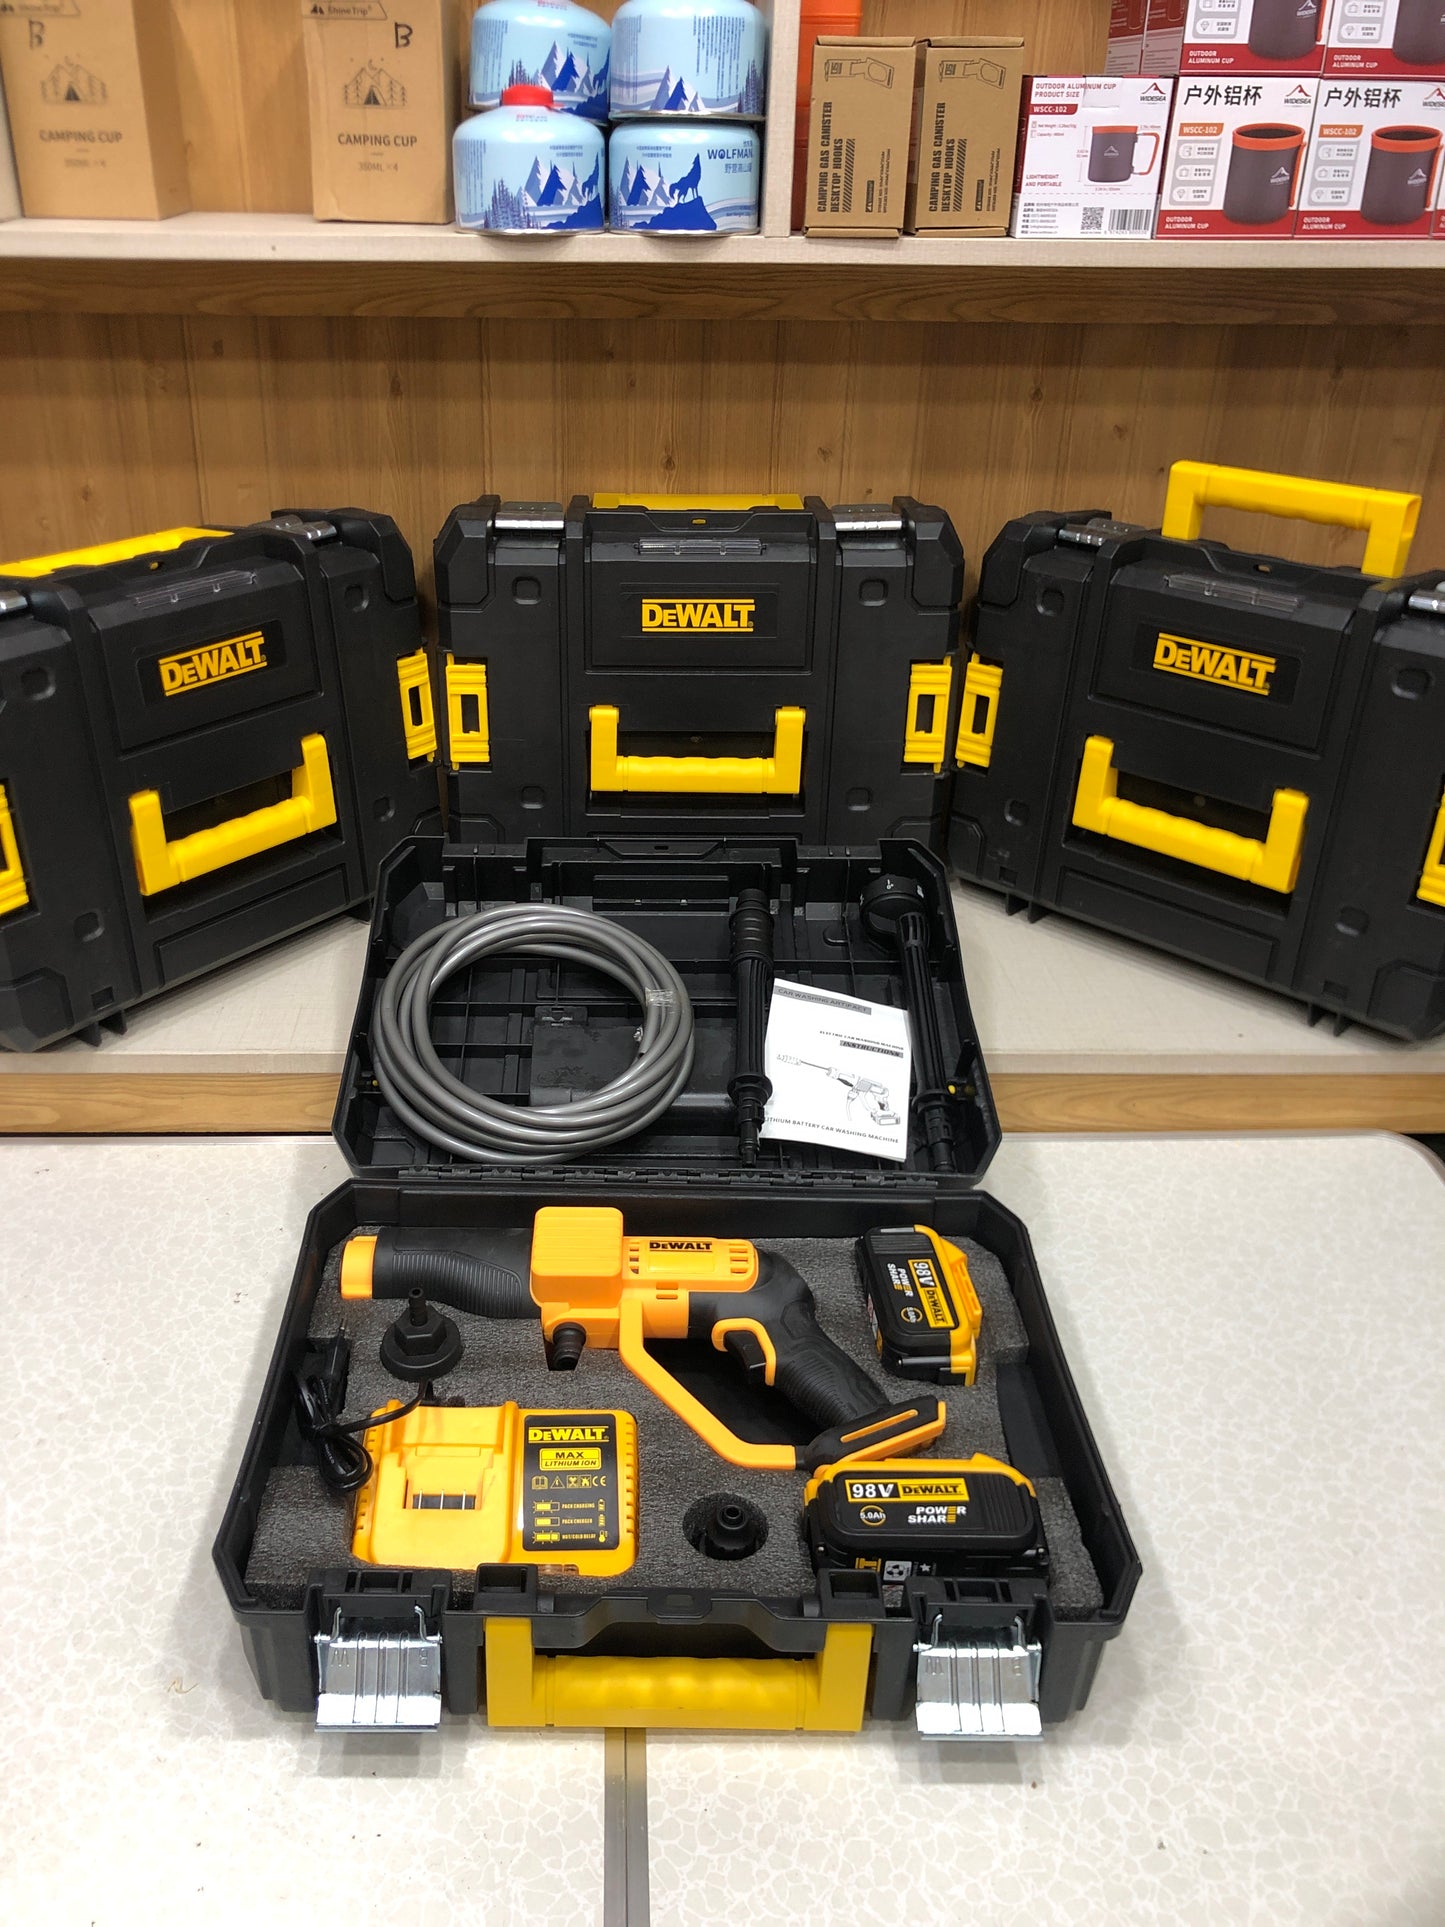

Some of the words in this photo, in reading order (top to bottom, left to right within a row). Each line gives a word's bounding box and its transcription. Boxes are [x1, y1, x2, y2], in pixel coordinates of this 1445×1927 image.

[28, 19, 45, 49] B
[394, 22, 413, 49] B
[1183, 85, 1263, 106] 户外铝杯
[1323, 87, 1403, 109] 户外铝杯
[821, 102, 832, 147] CANISTER
[934, 102, 946, 148] CANISTER
[1183, 126, 1218, 134] WSCC-102
[1323, 128, 1357, 136] WSCC-102
[39, 130, 96, 142] CAMPING
[98, 131, 123, 143] CUP
[338, 134, 391, 147] CAMPING
[393, 136, 417, 147] CUP
[707, 148, 753, 160] WOLFMAN
[819, 150, 830, 169] GAS
[832, 138, 843, 170] HOOKS
[932, 150, 942, 169] GAS
[944, 138, 955, 170] HOOKS
[817, 172, 829, 213] CAMPING
[830, 172, 841, 213] DESKTOP
[929, 171, 940, 212] CAMPING
[941, 172, 952, 212] DESKTOP
[778, 989, 794, 998] CAR
[794, 992, 829, 1004] WASHING
[843, 1041, 901, 1057] INSTRUCTIONS
[792, 1120, 820, 1129] BATTERY
[835, 1128, 867, 1138] WASHING
[868, 1134, 899, 1144] MACHINE
[887, 1263, 903, 1291] SHARE
[897, 1267, 914, 1297] POWER
[914, 1262, 935, 1286] 98V
[555, 1451, 584, 1459] MAX
[592, 1475, 607, 1487] CE
[852, 1483, 895, 1498] 98V
[860, 1511, 886, 1520] 5.0Ah
[907, 1515, 957, 1524] SHARE
[915, 1505, 967, 1515] POWER
